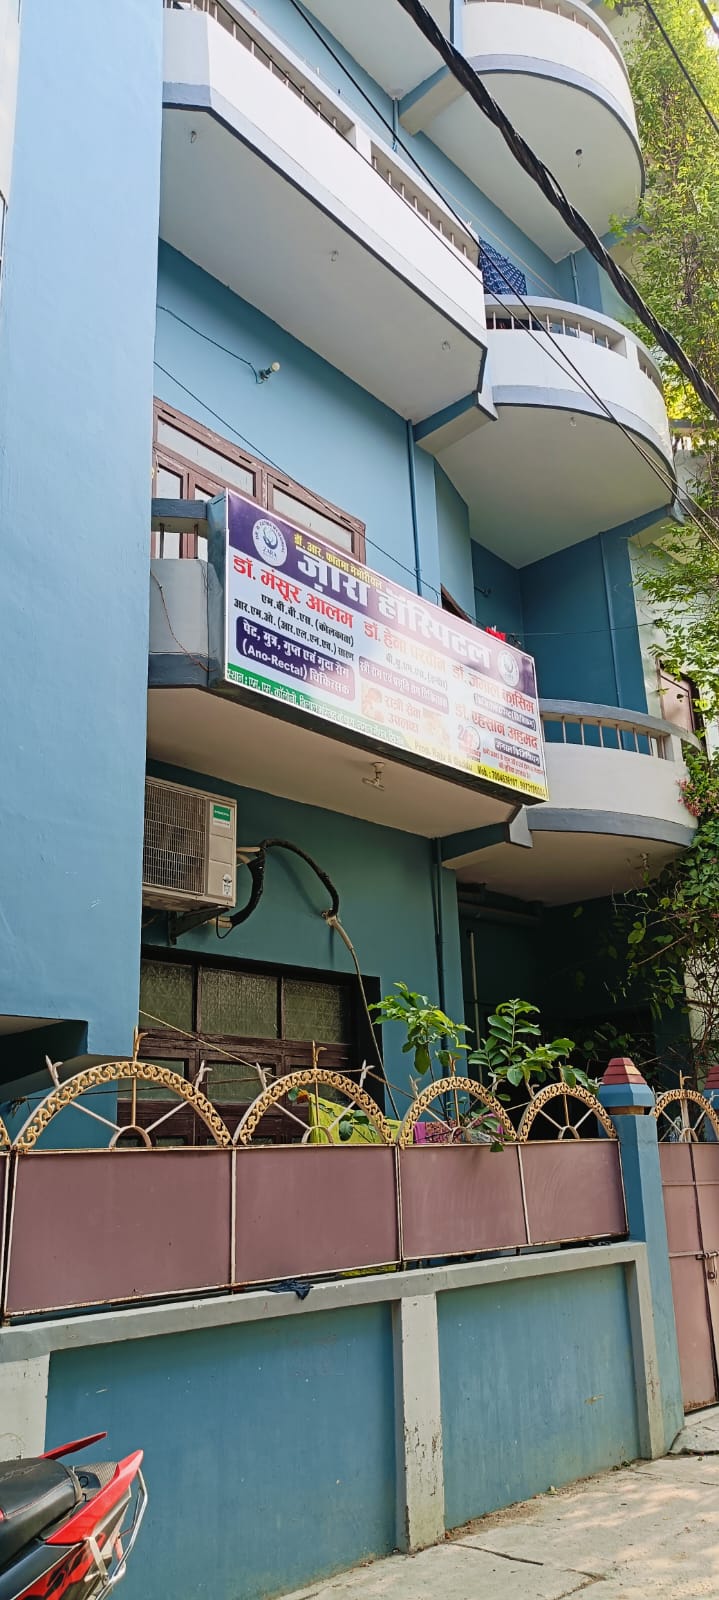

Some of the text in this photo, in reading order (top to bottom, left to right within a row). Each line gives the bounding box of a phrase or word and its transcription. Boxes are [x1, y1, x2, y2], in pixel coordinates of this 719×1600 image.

[233, 555, 354, 628] डॉ. मंसूर आलम
[243, 621, 260, 641] पेट,
[283, 641, 301, 661] गुप्त
[302, 646, 316, 664] एवं
[317, 657, 333, 675] गुदा
[335, 661, 349, 677] रोग
[364, 620, 381, 641] डॉ.
[375, 587, 492, 669] हॉस्पिटल
[242, 639, 349, 694] (Ano-Rectal) चिकित्सक
[508, 726, 538, 748] अहमद
